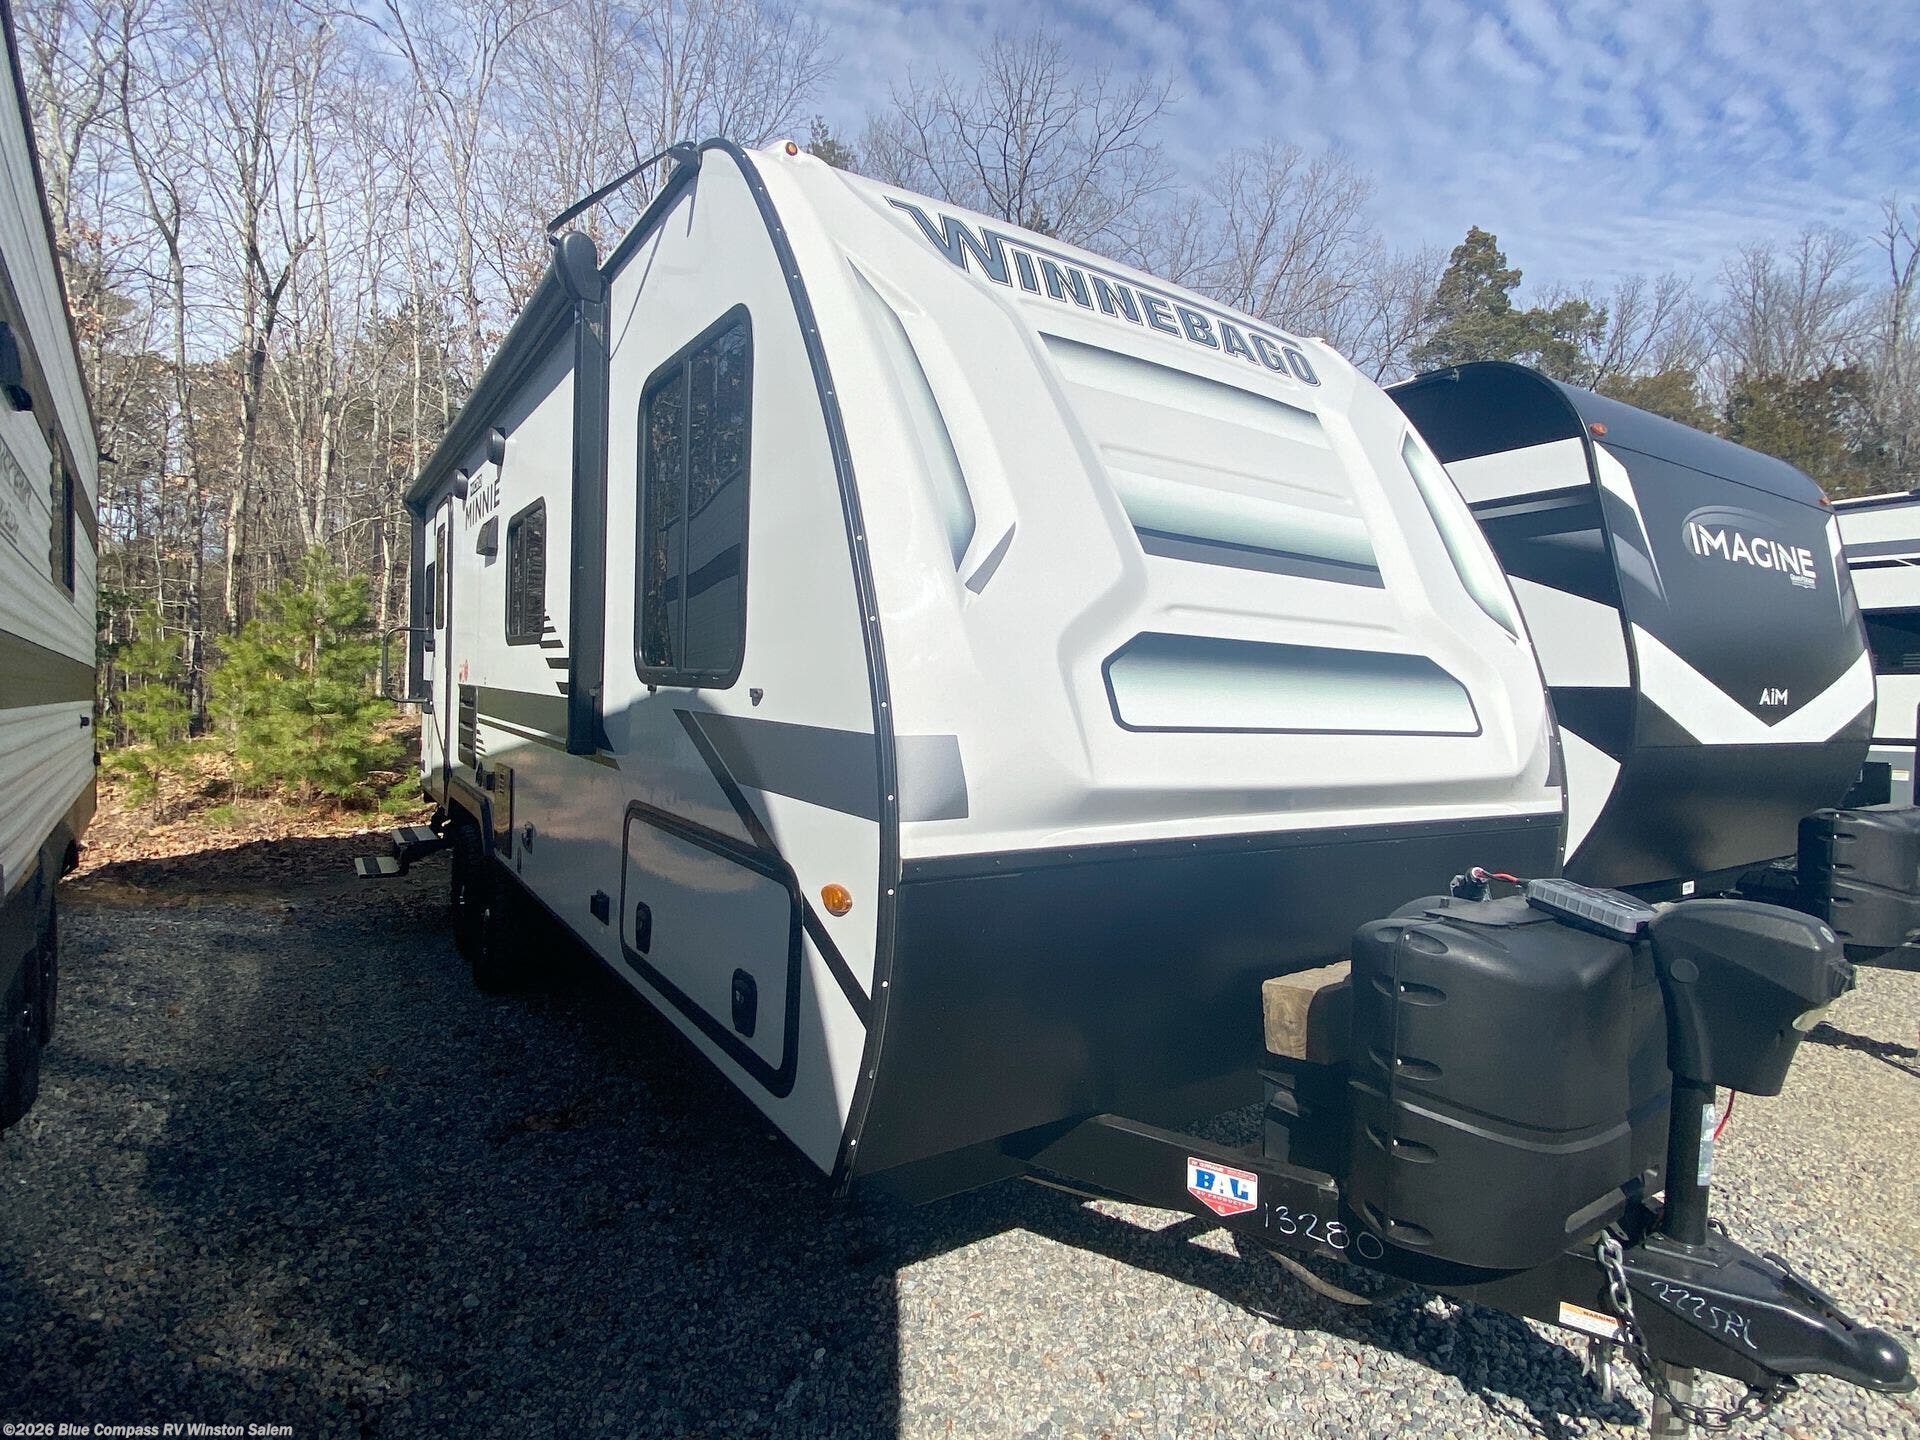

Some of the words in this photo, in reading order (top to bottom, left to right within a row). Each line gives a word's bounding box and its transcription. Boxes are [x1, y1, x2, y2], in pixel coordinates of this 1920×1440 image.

[883, 195, 1321, 387] WINNEBAGO
[465, 478, 500, 531] MINNIE
[1689, 521, 1817, 579] IMAGINE
[1195, 1168, 1249, 1201] BAL
[1264, 1202, 1384, 1260] 13280
[1583, 1310, 1616, 1325] WARNING
